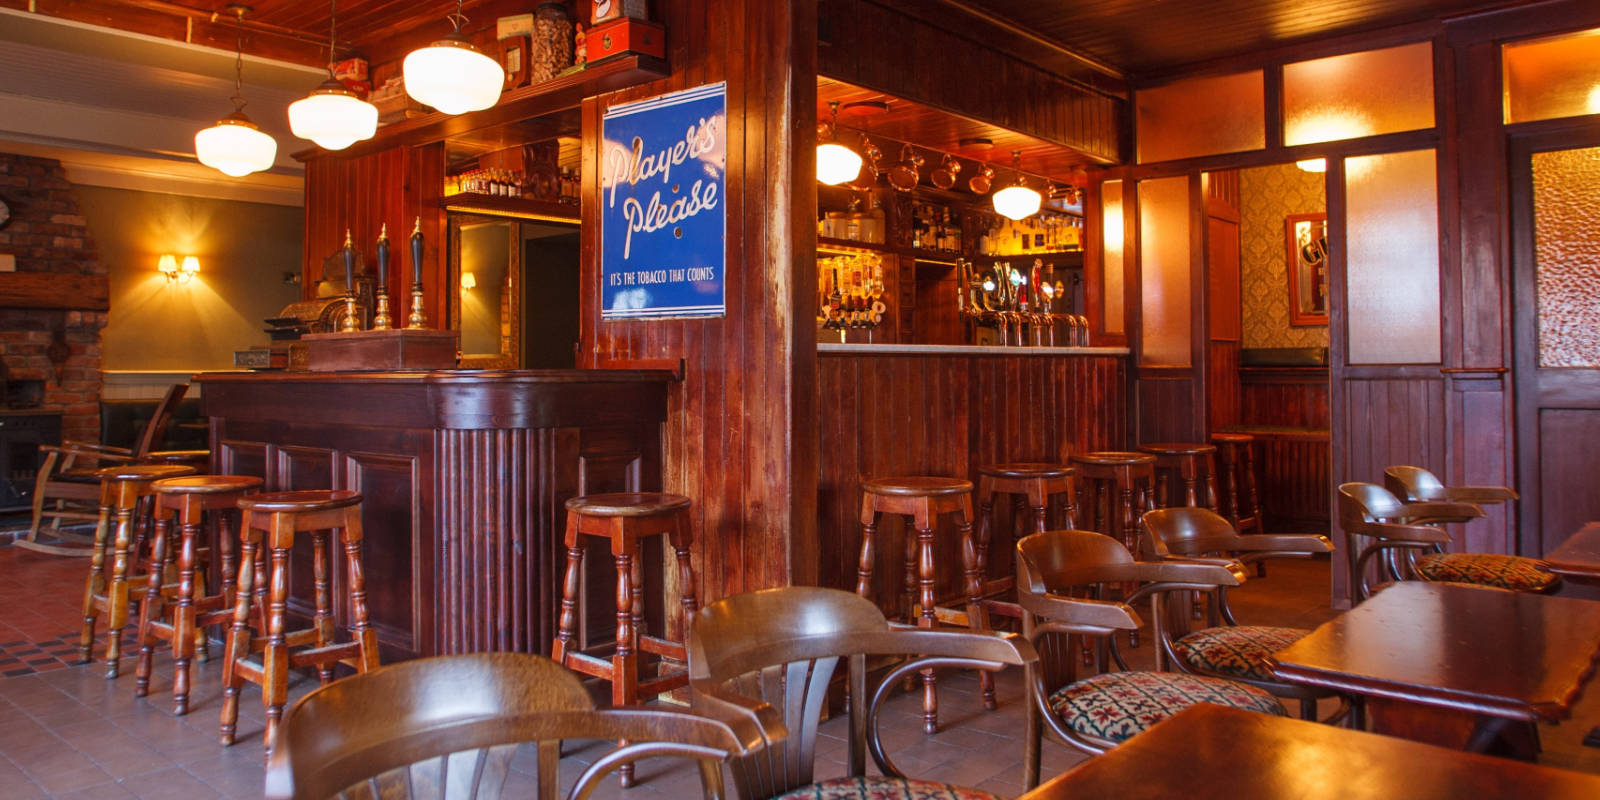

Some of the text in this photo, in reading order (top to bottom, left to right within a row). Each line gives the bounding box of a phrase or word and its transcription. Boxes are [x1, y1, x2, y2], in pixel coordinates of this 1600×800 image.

[610, 117, 716, 208] Player's
[623, 179, 718, 260] Please
[623, 271, 635, 286] THE
[637, 269, 667, 285] TOBACCO
[669, 268, 685, 283] THAT
[687, 266, 714, 281] COUNTS
